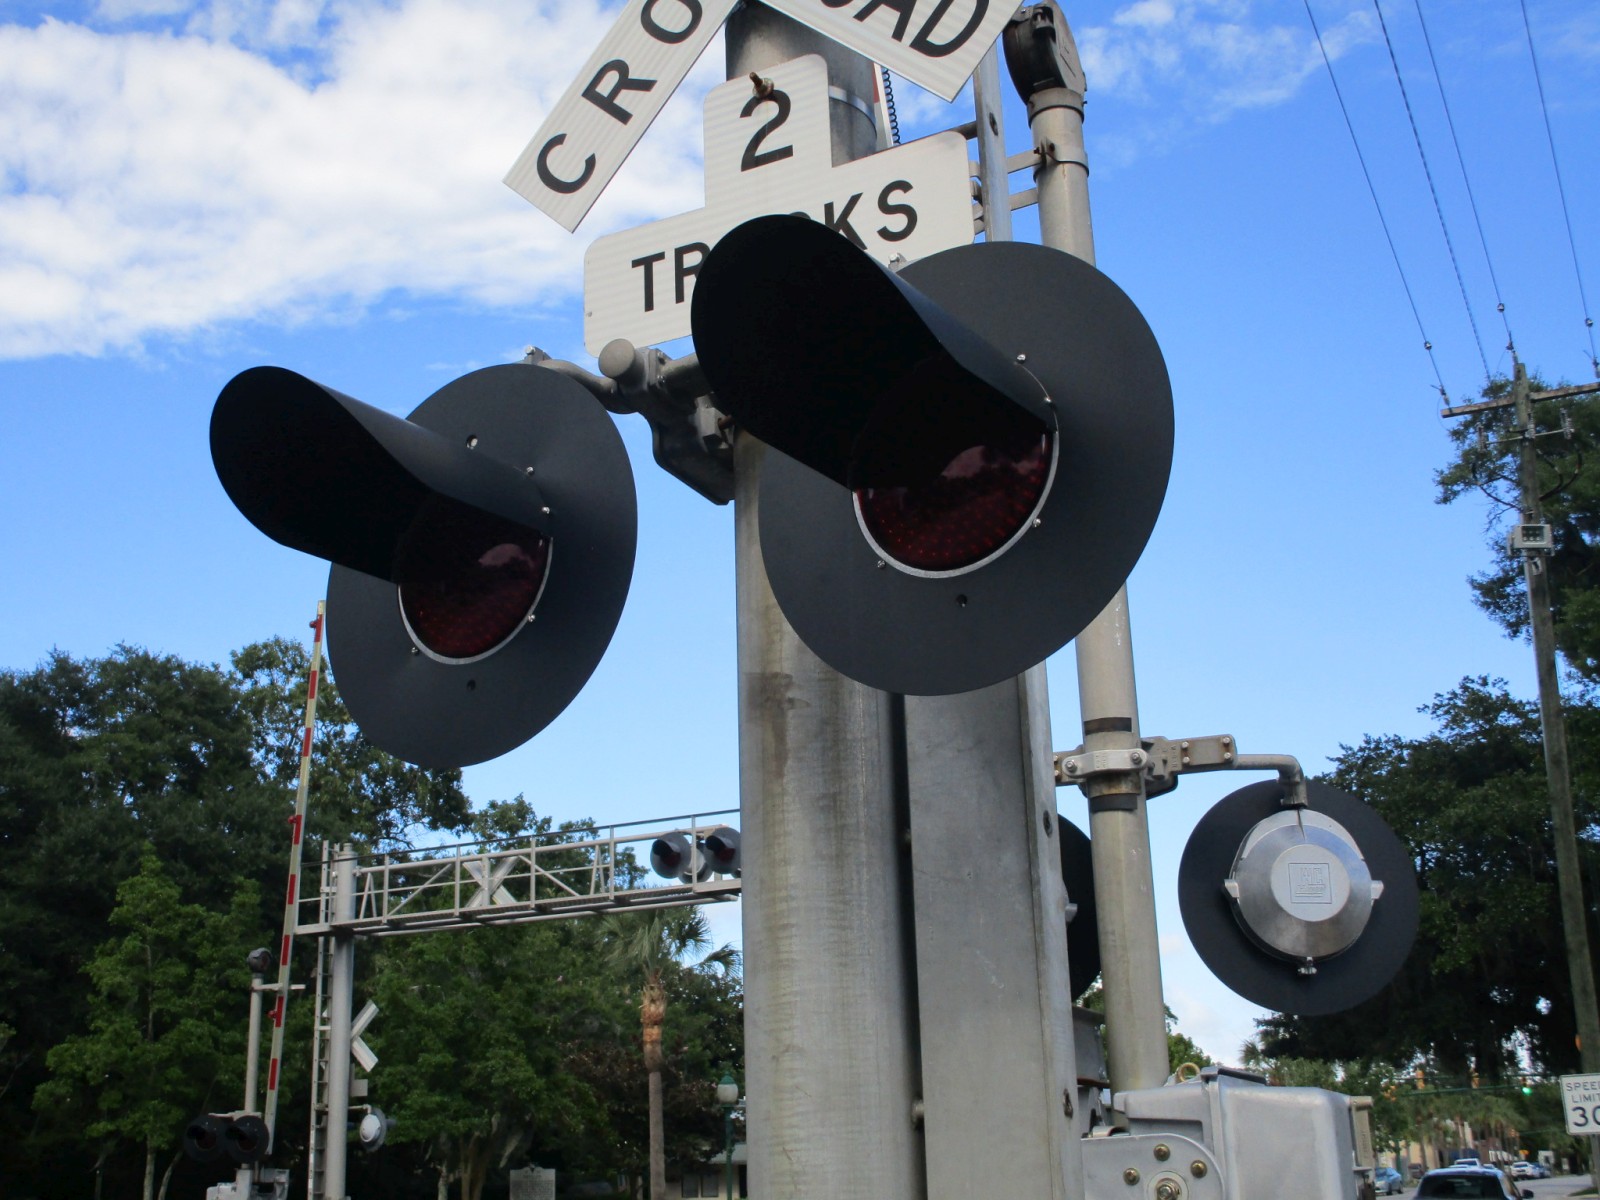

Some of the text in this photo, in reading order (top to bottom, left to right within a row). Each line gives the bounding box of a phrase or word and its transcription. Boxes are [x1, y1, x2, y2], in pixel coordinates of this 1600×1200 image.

[819, 0, 990, 58] AD
[738, 89, 794, 173] 2
[631, 179, 918, 313] TRKS
